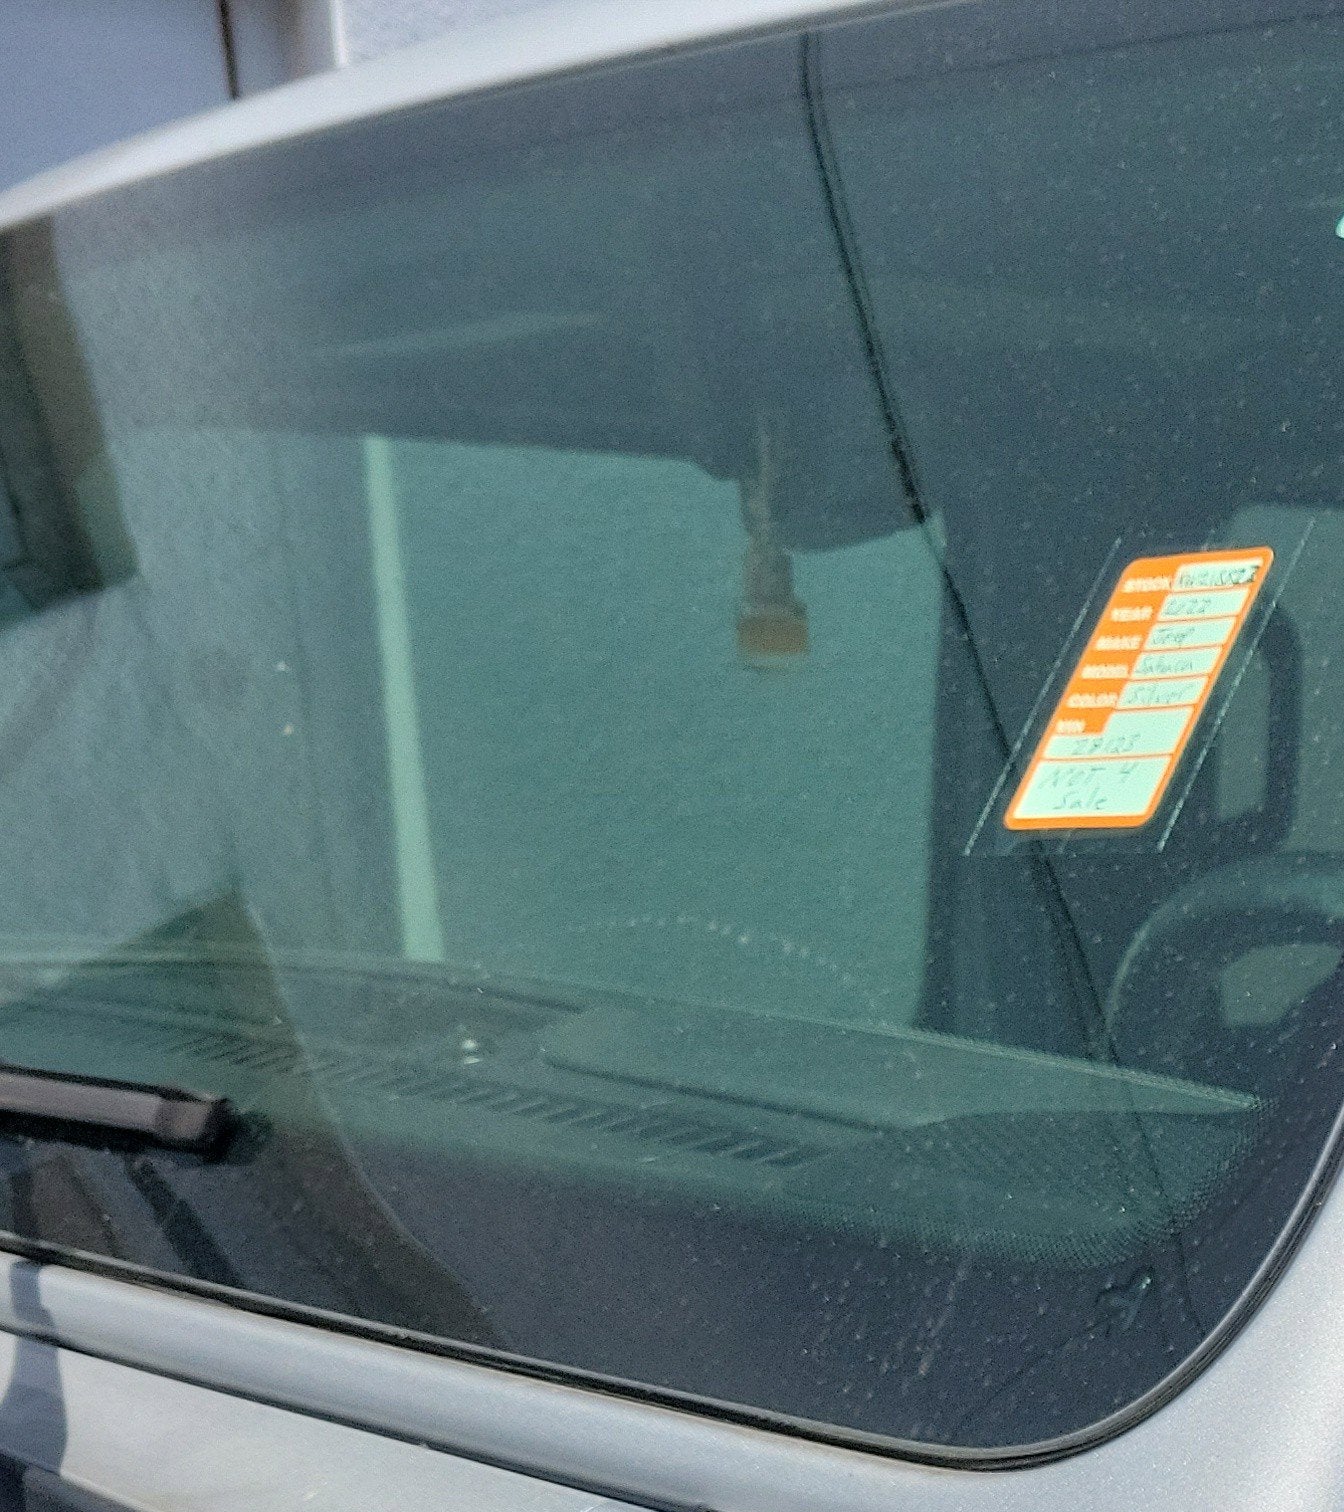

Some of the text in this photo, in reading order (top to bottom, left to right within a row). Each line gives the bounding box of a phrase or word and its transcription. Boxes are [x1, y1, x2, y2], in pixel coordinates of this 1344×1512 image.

[1111, 606, 1154, 622] YEAR
[1095, 635, 1143, 651] MAKE
[1066, 693, 1118, 709] COLOR
[1055, 719, 1086, 734] VIN
[1052, 786, 1109, 811] Sale
